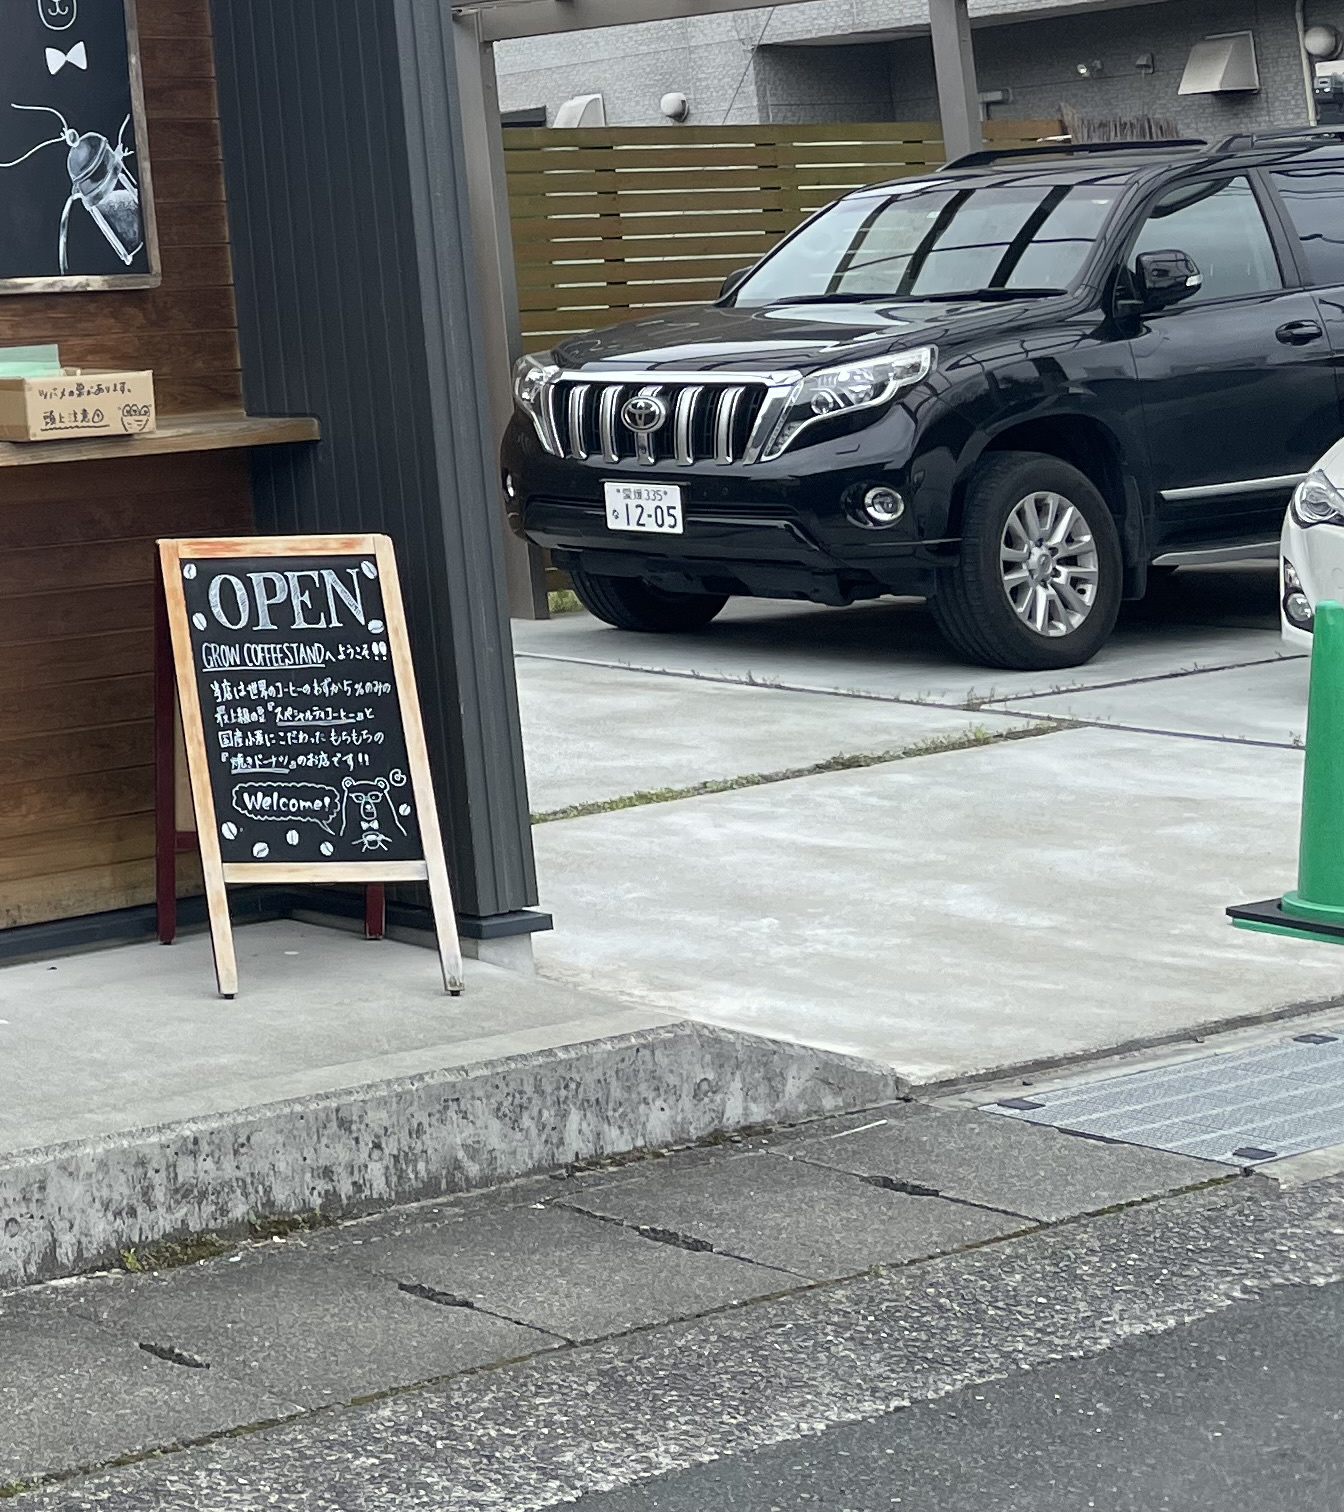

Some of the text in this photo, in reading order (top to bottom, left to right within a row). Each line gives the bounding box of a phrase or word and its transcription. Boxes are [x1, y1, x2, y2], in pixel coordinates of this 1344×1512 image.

[626, 503, 677, 529] 12-05
[208, 569, 365, 630] OPEN
[202, 642, 240, 668] GROW
[243, 791, 331, 812] Welcome!
